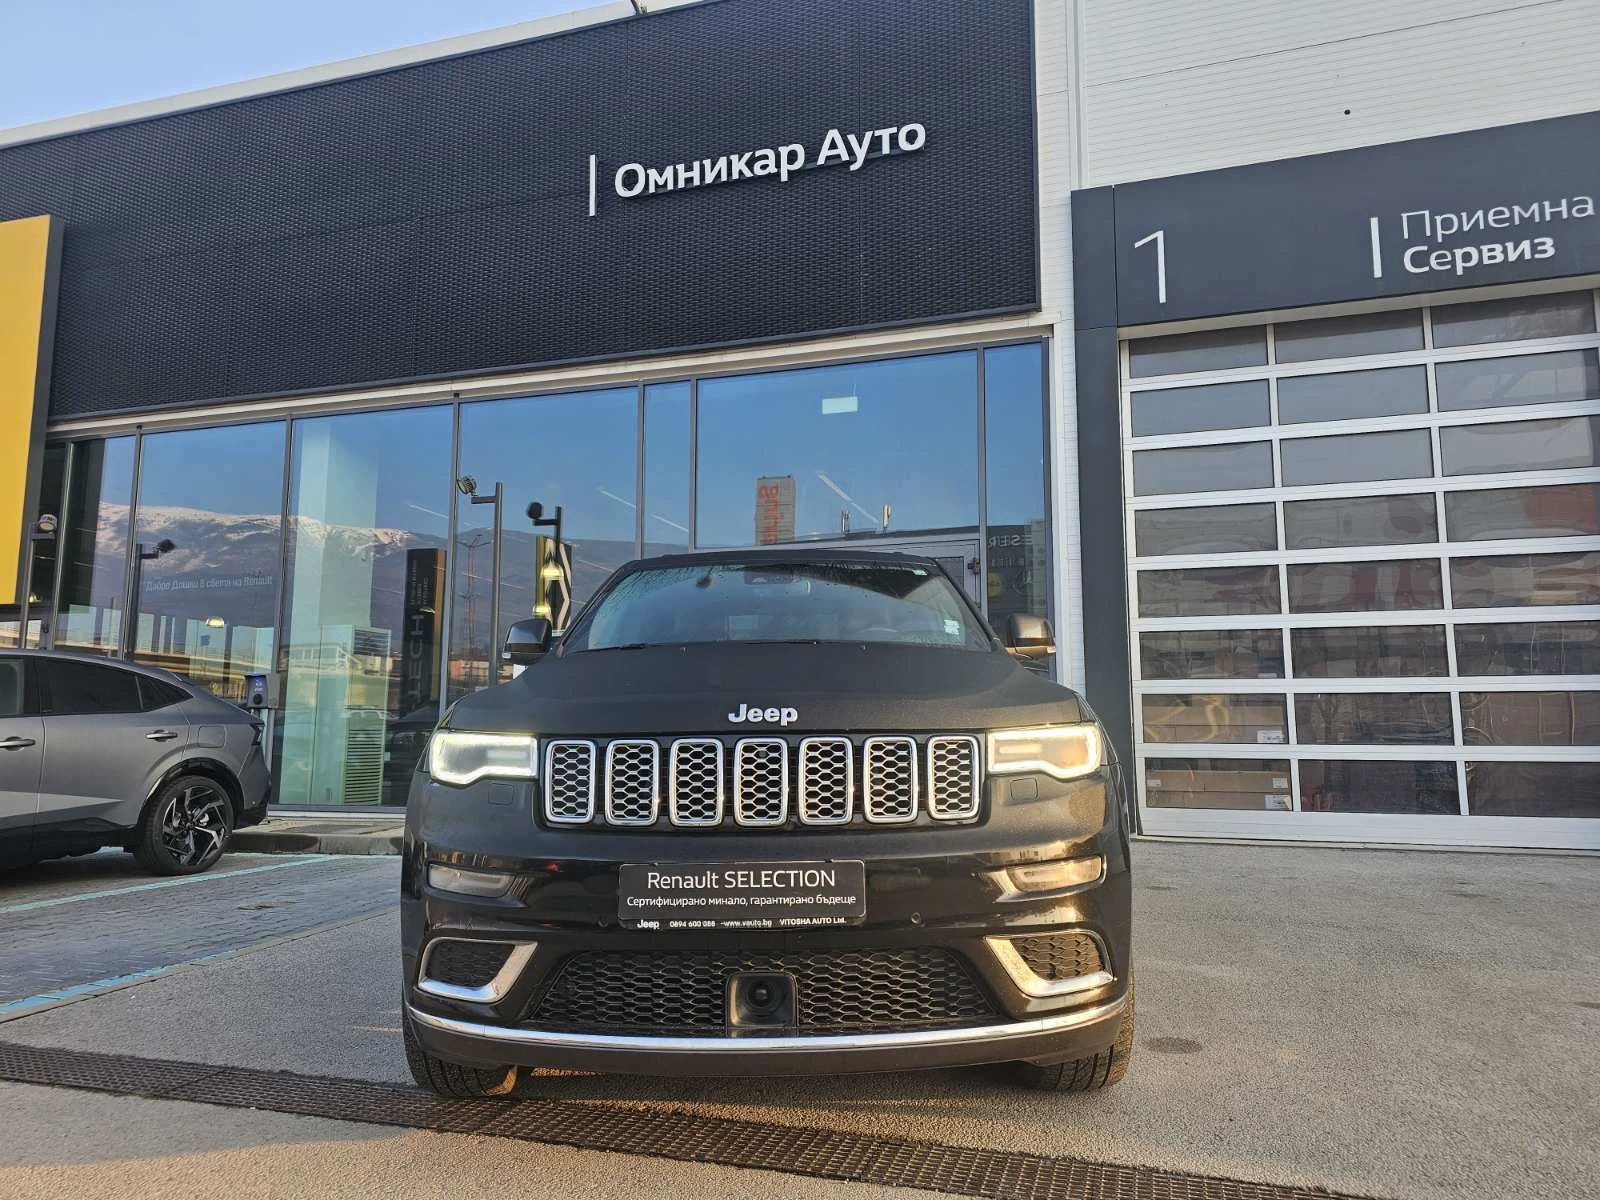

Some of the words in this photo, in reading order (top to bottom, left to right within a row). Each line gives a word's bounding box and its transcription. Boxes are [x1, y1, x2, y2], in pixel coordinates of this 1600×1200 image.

[614, 142, 805, 198] Омникар
[816, 122, 926, 171] Ауто
[1401, 195, 1595, 242] Приемна
[1134, 230, 1167, 304] 1
[1403, 237, 1556, 276] Сервиз
[728, 703, 798, 727] Jeep
[647, 871, 719, 889] Renault
[724, 869, 836, 889] SELECTION
[627, 896, 706, 907] Сертифицирано
[708, 895, 748, 906] минало,
[750, 895, 814, 907] гарантирано
[815, 894, 857, 906] бъдеще
[637, 919, 660, 930] Jeep
[779, 917, 811, 926] VITOSHA
[811, 917, 832, 925] AUTO
